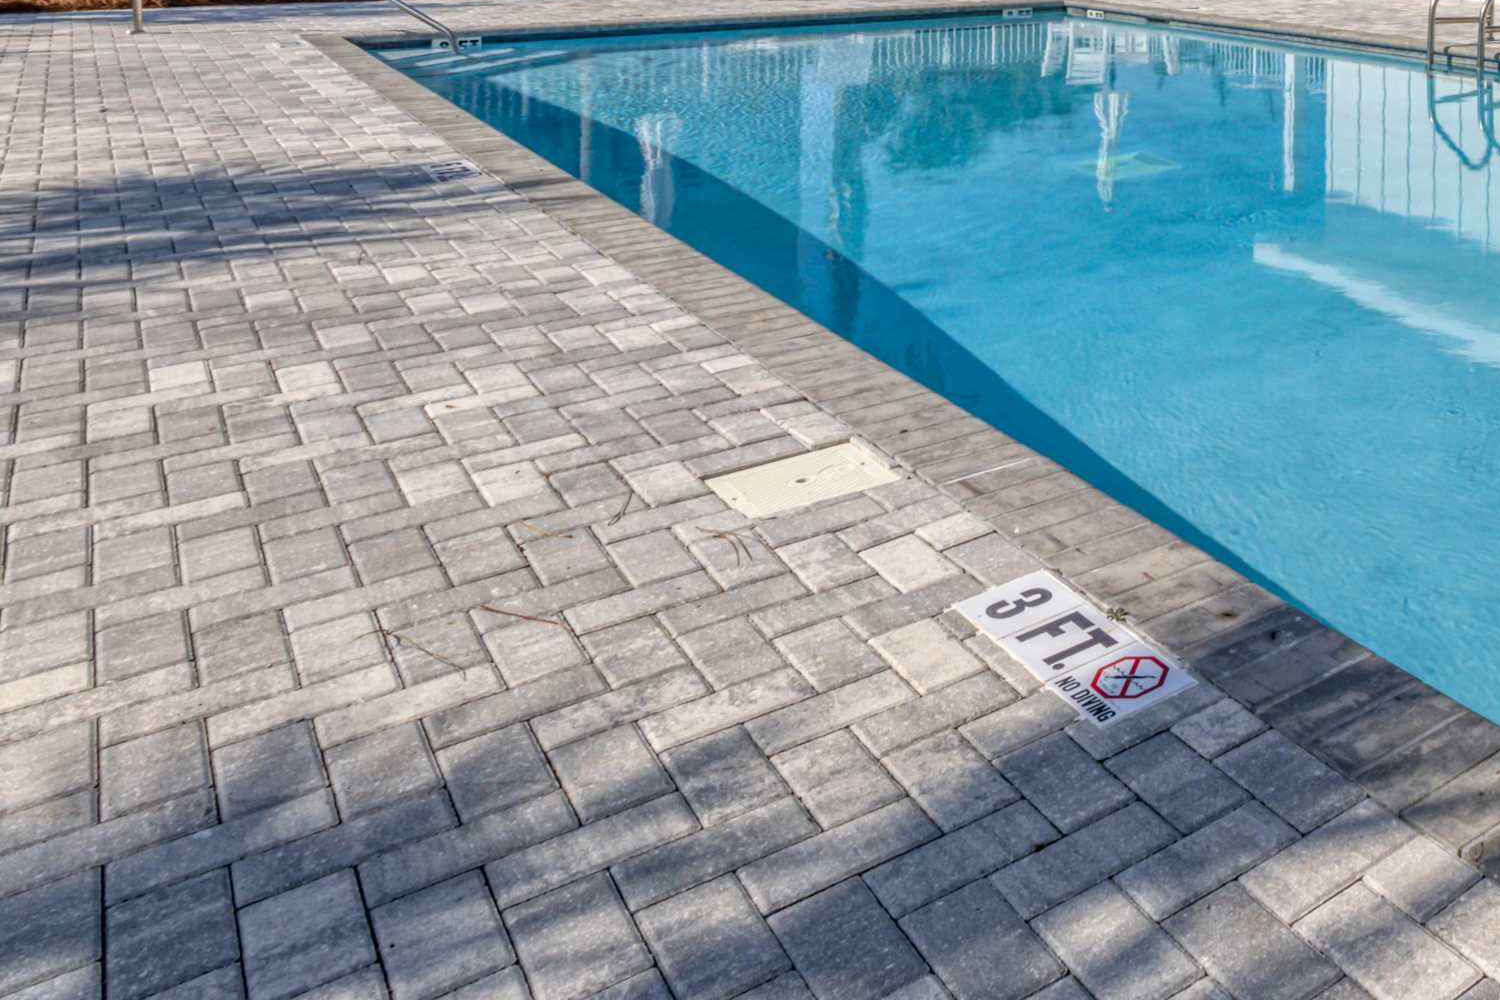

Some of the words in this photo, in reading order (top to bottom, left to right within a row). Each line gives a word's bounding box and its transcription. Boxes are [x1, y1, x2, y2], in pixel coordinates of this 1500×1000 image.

[986, 588, 1053, 619] 3
[1015, 611, 1119, 670] FT.
[1055, 675, 1080, 693] NO
[1071, 688, 1117, 723] DIVING
